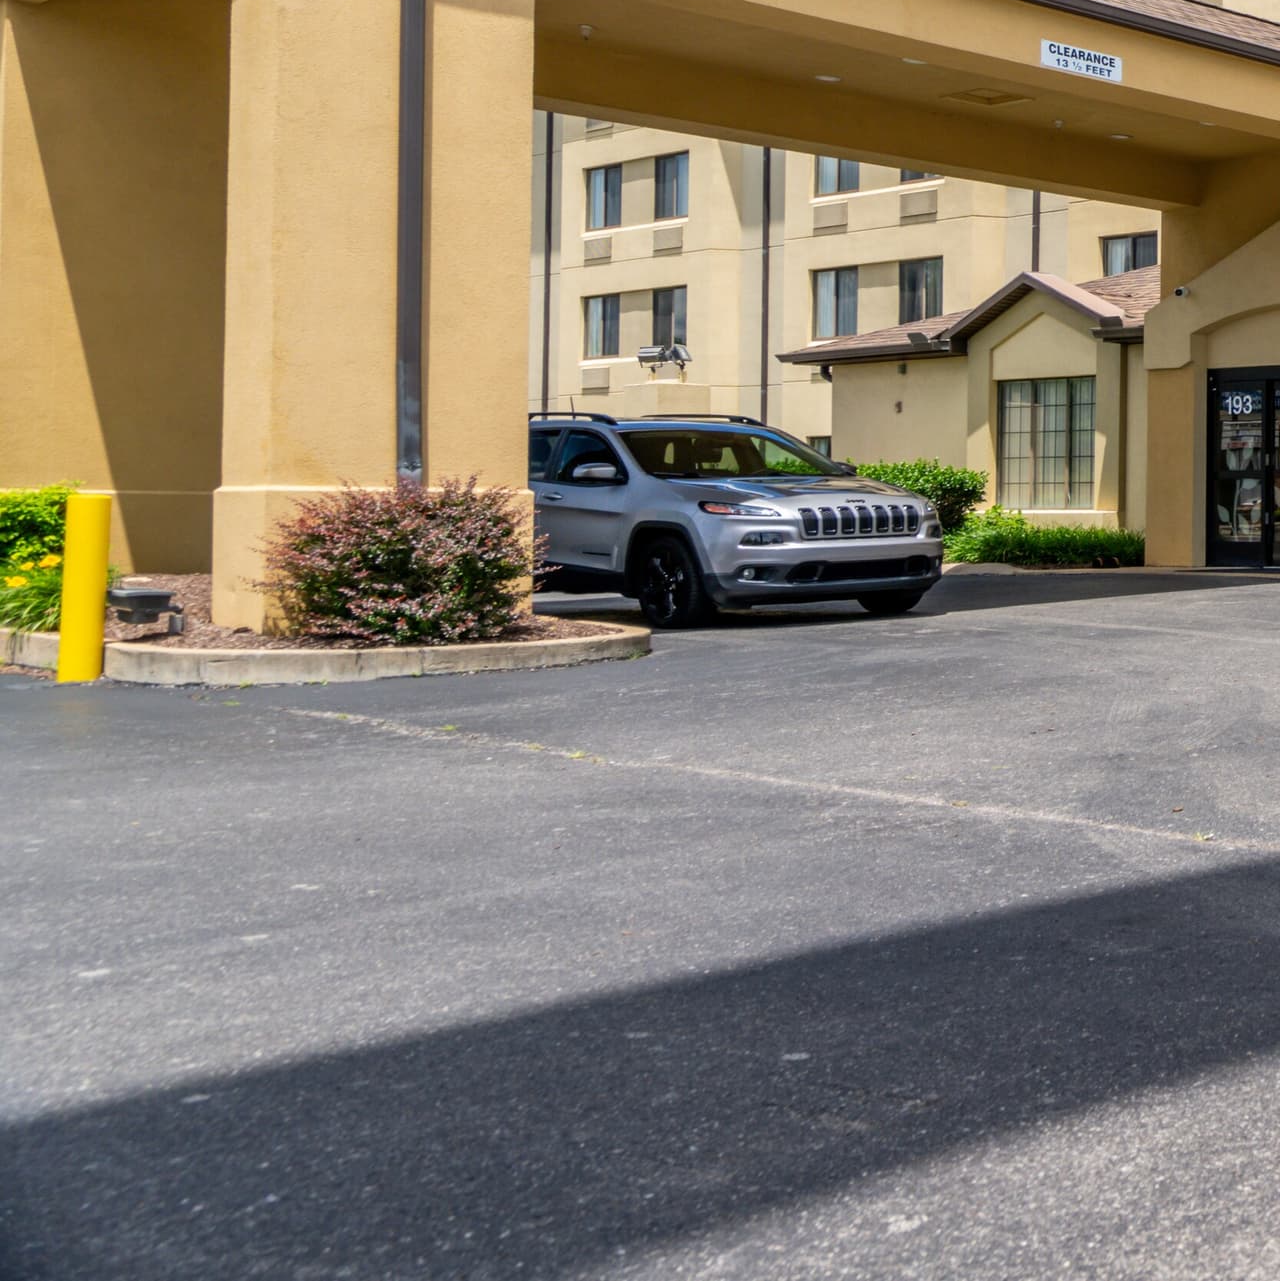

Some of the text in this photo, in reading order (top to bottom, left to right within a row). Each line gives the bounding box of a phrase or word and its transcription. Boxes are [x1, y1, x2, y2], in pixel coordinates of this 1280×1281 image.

[1048, 43, 1116, 68] CLEARANCE
[1056, 58, 1069, 68] 13
[1086, 64, 1113, 78] FEET
[1225, 395, 1253, 415] 193
